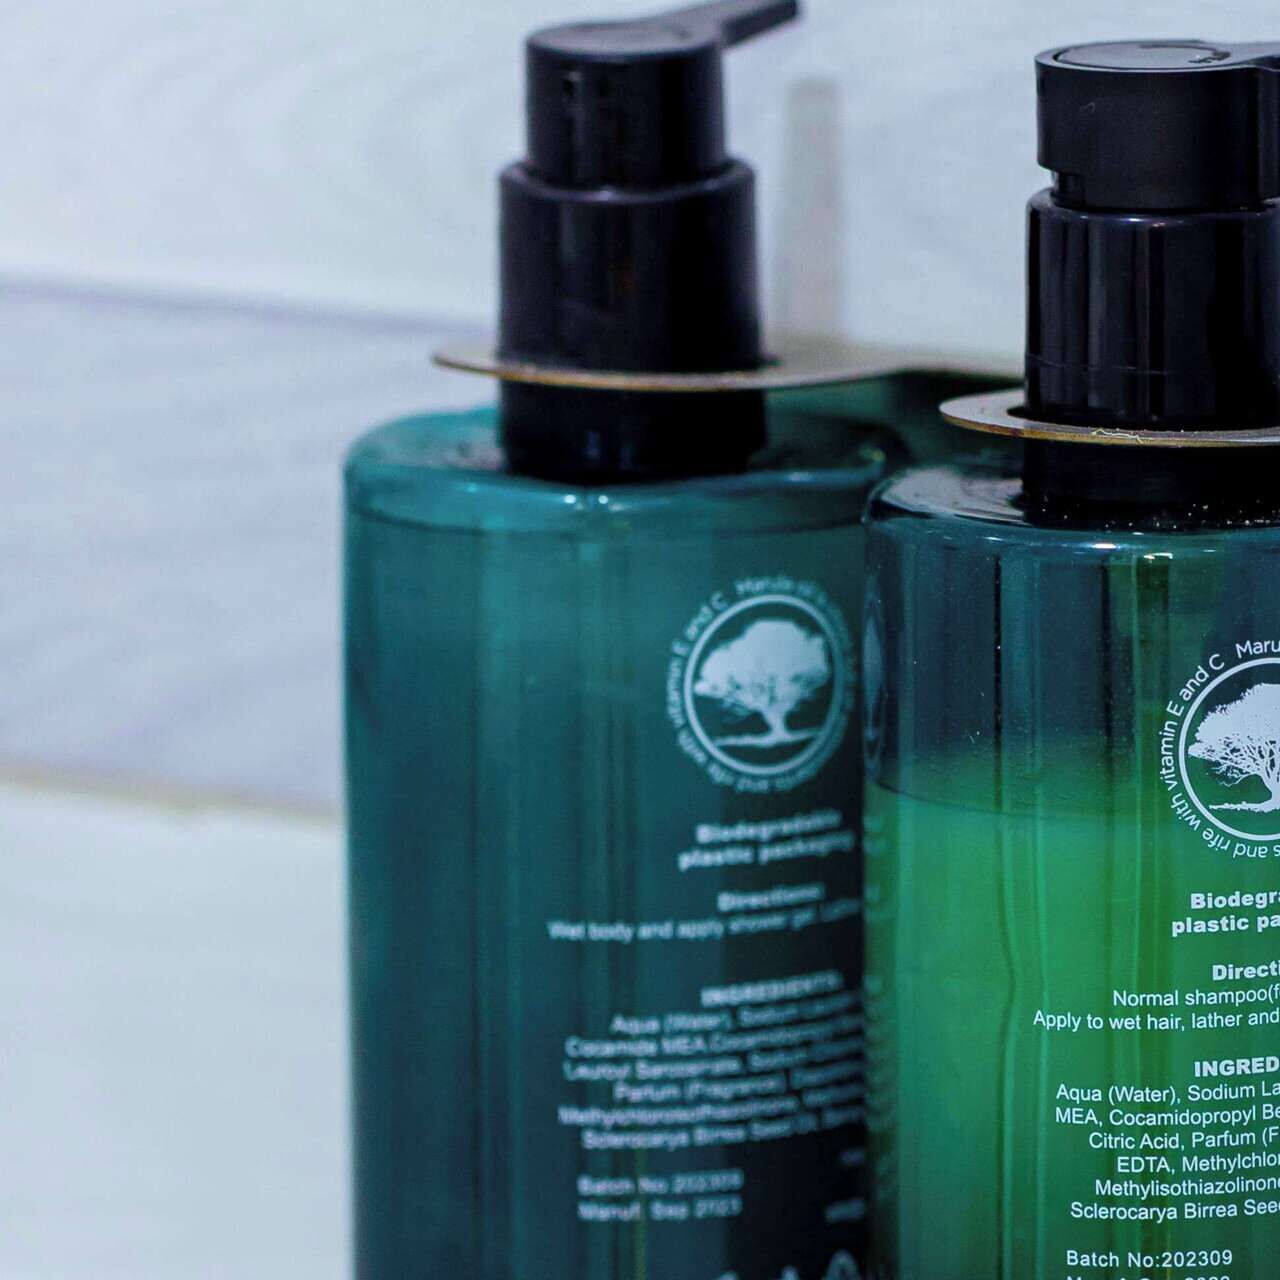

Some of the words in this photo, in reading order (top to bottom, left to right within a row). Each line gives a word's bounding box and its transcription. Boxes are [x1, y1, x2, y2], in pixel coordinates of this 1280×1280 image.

[1208, 653, 1225, 671] C
[1179, 665, 1210, 702] and
[1166, 700, 1185, 718] E
[1158, 720, 1178, 791] vitamin
[1171, 792, 1202, 831] with
[1202, 827, 1230, 853] rife
[1232, 842, 1269, 859] and
[1171, 915, 1250, 938] plastic
[1113, 990, 1179, 1008] Normal
[1033, 1009, 1081, 1032] Apply
[1086, 1013, 1104, 1030] to
[1108, 1014, 1141, 1030] wet
[1147, 1012, 1185, 1032] hair,
[1191, 1010, 1242, 1029] lather
[1247, 1007, 1280, 1026] and
[1056, 1083, 1102, 1105] Aqua
[1108, 1086, 1181, 1106] (Water),
[1187, 1083, 1255, 1102] Sodium
[1055, 1108, 1103, 1128] MEA,
[1109, 1106, 1256, 1128] Cocamidopropyl
[1089, 1131, 1135, 1150] Citric
[1140, 1131, 1185, 1152] Acid,
[1191, 1129, 1256, 1149] Parfum
[1117, 1157, 1175, 1174] EDTA,
[1070, 1201, 1178, 1224] Sclerocarya
[1184, 1198, 1238, 1219] Birrea
[1066, 1249, 1119, 1267] Batch
[1127, 1248, 1233, 1268] No:202309
